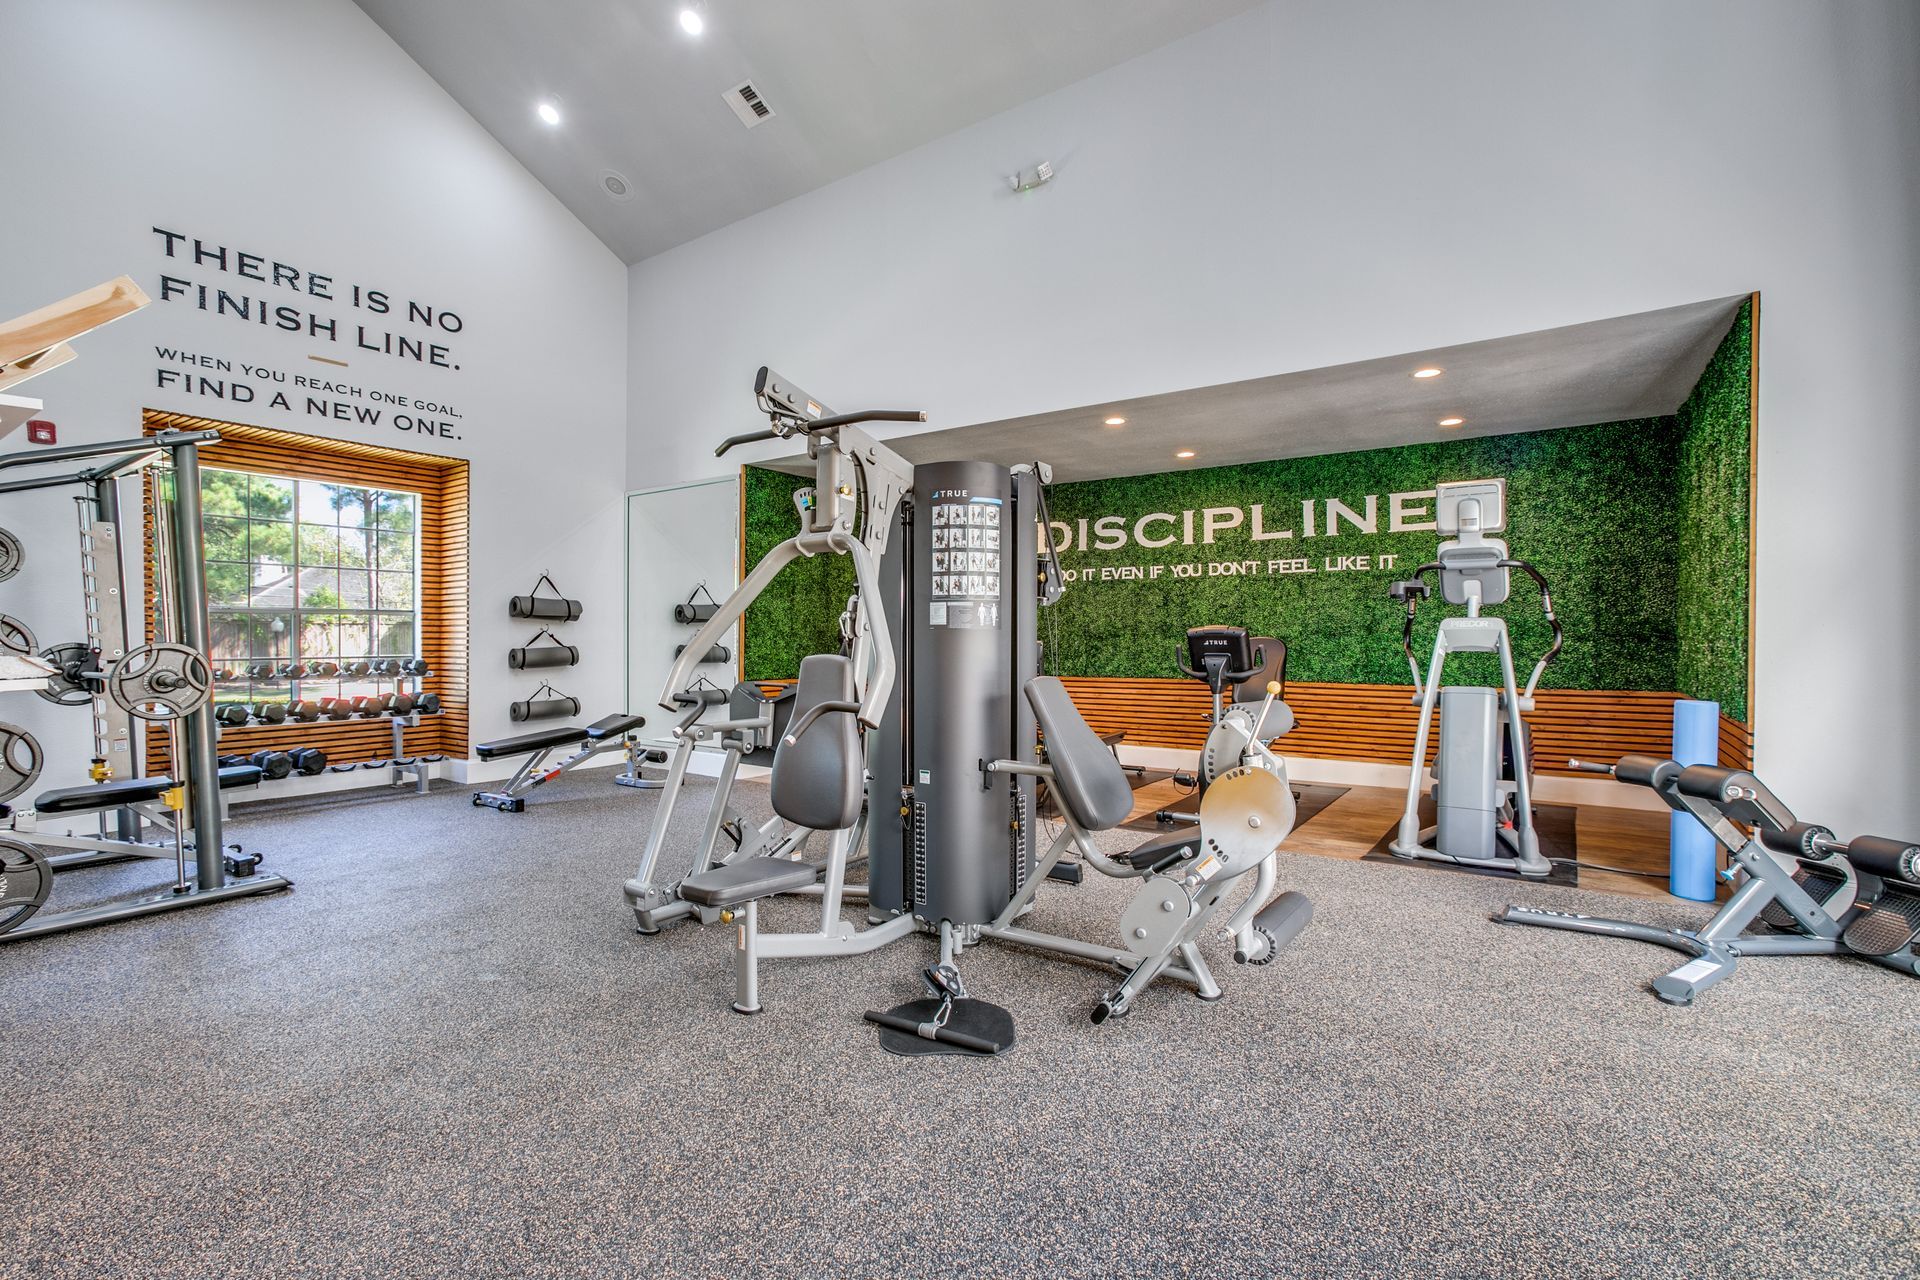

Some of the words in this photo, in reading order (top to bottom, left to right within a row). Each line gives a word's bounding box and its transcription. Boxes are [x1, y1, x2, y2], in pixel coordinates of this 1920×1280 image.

[153, 226, 333, 301] THERE
[353, 285, 389, 313] IS
[409, 301, 462, 333] NO
[160, 274, 336, 341] FINISH
[357, 326, 460, 370] LINE.
[155, 346, 231, 372] WHEN
[241, 364, 285, 382] YOU
[295, 375, 361, 398] REACH
[370, 391, 407, 408] ONE
[157, 369, 254, 402] FIND
[269, 392, 291, 411] A
[307, 397, 381, 425] NEW
[394, 415, 461, 440] ONE.
[940, 489, 968, 498] TRUE
[1037, 489, 1437, 554] DISCIPLINE
[1083, 568, 1095, 581] IT
[1101, 566, 1144, 580] EVEN
[1150, 565, 1165, 579] IF
[1170, 563, 1202, 578] YOU
[1208, 560, 1261, 576] DON'T
[1268, 558, 1316, 574] FEEL
[1326, 555, 1369, 571] LIKE
[1379, 554, 1398, 570] IT
[1451, 620, 1488, 628] PRECOR
